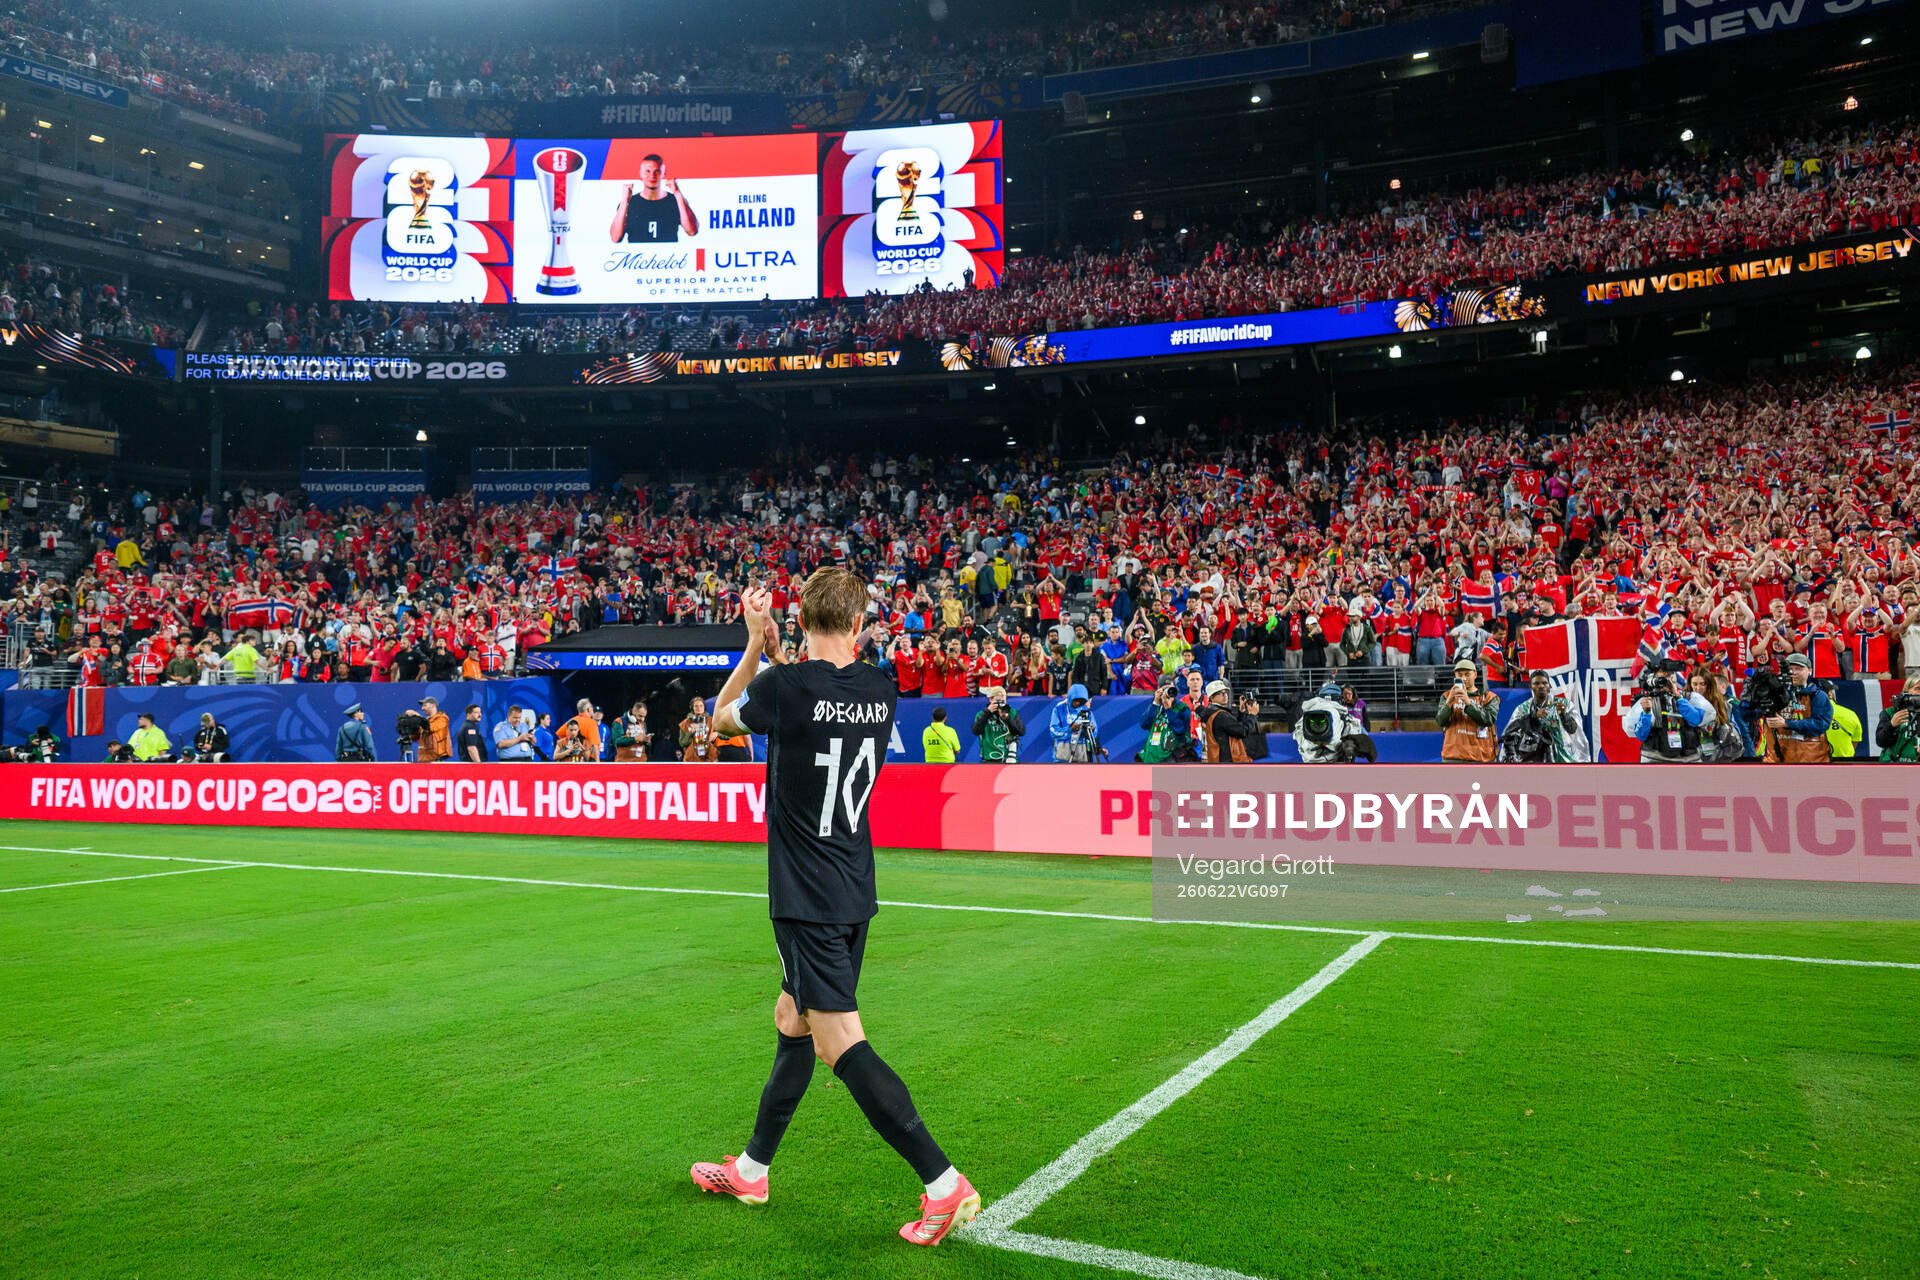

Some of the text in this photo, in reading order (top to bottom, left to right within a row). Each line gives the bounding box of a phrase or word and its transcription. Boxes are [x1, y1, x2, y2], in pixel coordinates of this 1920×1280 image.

[1663, 0, 1804, 51] NEW
[13, 63, 114, 99] JERSEY
[601, 103, 733, 125] #FIFAWorldCup
[738, 193, 768, 204] ERLING
[709, 206, 796, 230] HAALAND
[406, 233, 436, 245] FIFA
[895, 225, 923, 237] FIFA
[386, 255, 454, 267] WORLD CUP
[603, 250, 797, 273] Michelob ULTRA
[876, 246, 941, 260] WORLD CUP
[384, 267, 453, 282] 2026
[876, 257, 942, 276] 2026
[1585, 237, 1913, 302] NEW YORK NEW JERSEY
[636, 274, 768, 285] SUPERIOR PLAYER
[649, 285, 755, 296] OF THE MATCH
[1170, 323, 1273, 346] #FIFAWorldCup
[185, 353, 234, 365] PLEASE
[263, 354, 299, 366] YOUR
[300, 355, 342, 367] HANDS
[343, 356, 411, 368] TOGETHER
[676, 349, 902, 375] NEW YORK NEW JERSEY
[185, 367, 212, 379] FOR
[374, 361, 421, 380] CUP
[425, 361, 507, 380] 2026
[300, 482, 324, 493] FIFA
[324, 482, 364, 493] WORLD
[364, 482, 387, 493] CUP
[472, 482, 495, 493] FIFA
[495, 482, 532, 492] WORLD
[554, 481, 591, 492] 2026
[585, 654, 730, 667] FIFA WORLD CUP 2026
[812, 699, 889, 724] ØDEGAARD
[814, 737, 877, 837] 10
[30, 777, 86, 808] FIFA
[89, 777, 193, 811] WORLD
[196, 778, 239, 813] CUP
[240, 778, 374, 814] 2026
[388, 779, 528, 817] OFFICIAL
[534, 779, 767, 824] HOSPITALITY
[1414, 791, 1920, 858] EXPERIENCE
